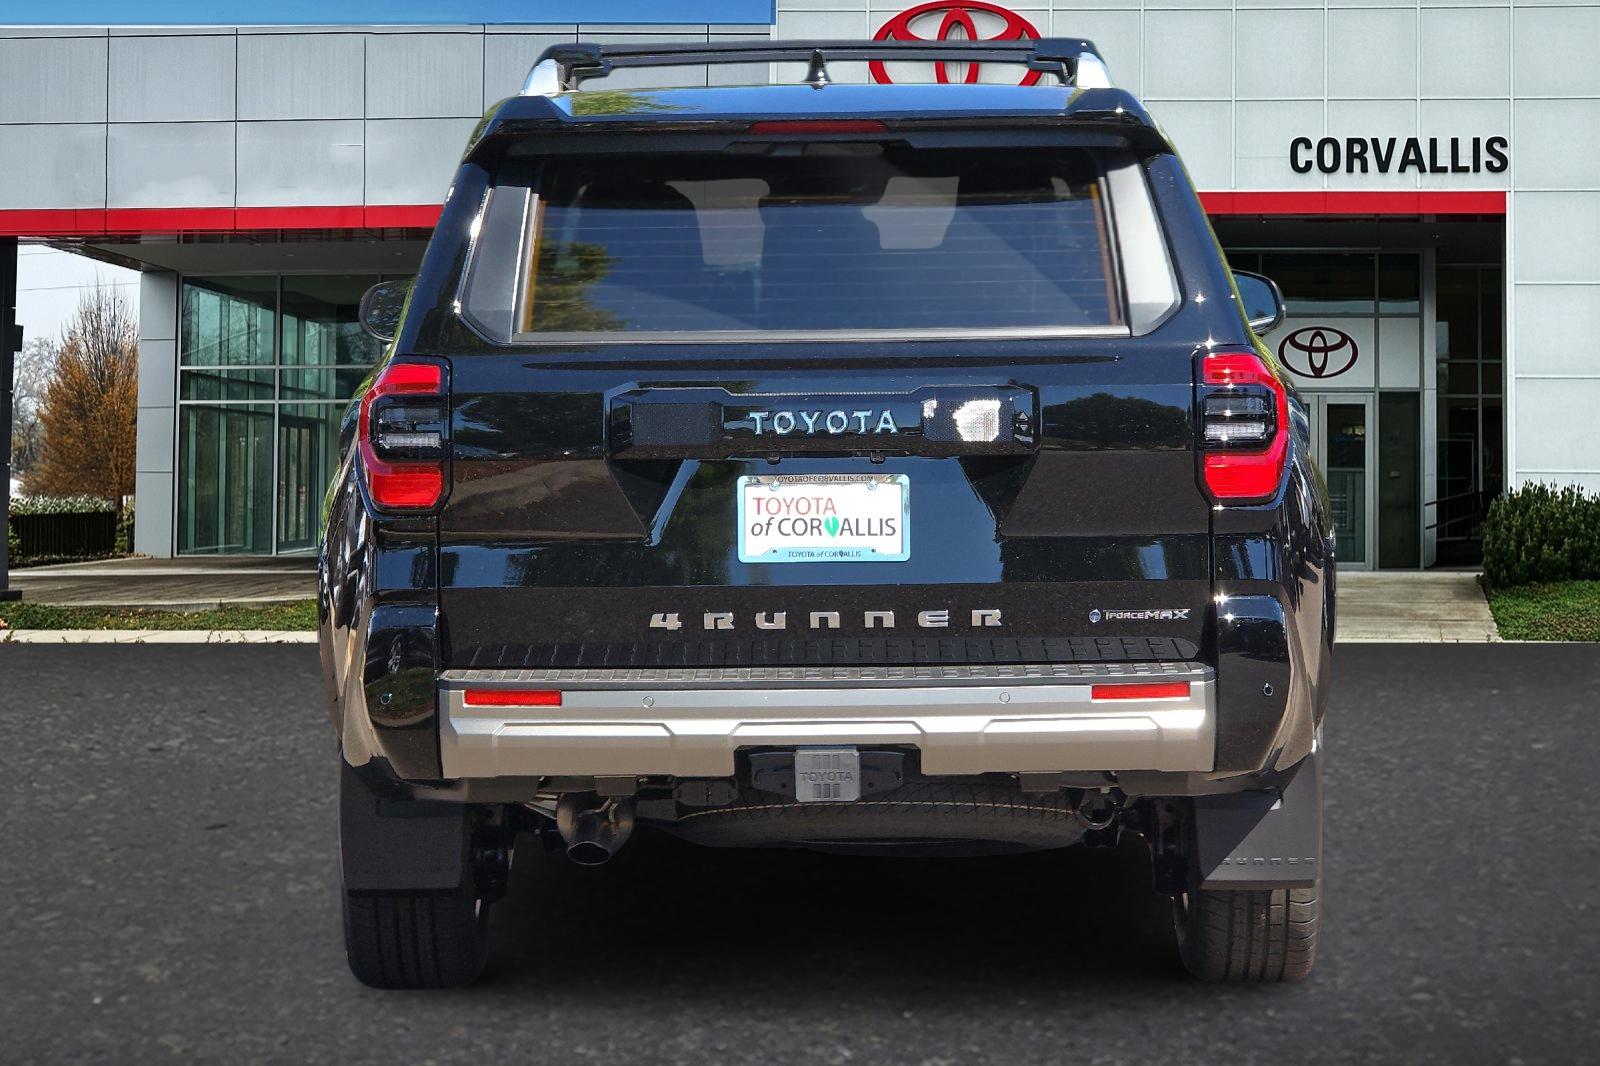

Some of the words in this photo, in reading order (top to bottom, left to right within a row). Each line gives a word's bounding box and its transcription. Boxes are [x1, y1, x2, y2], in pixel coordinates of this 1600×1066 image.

[1289, 136, 1509, 174] CORVALLIS
[749, 410, 899, 435] TOYOTA
[752, 496, 837, 515] TOYOTA
[751, 516, 775, 537] of
[800, 771, 853, 782] TOYOTA
